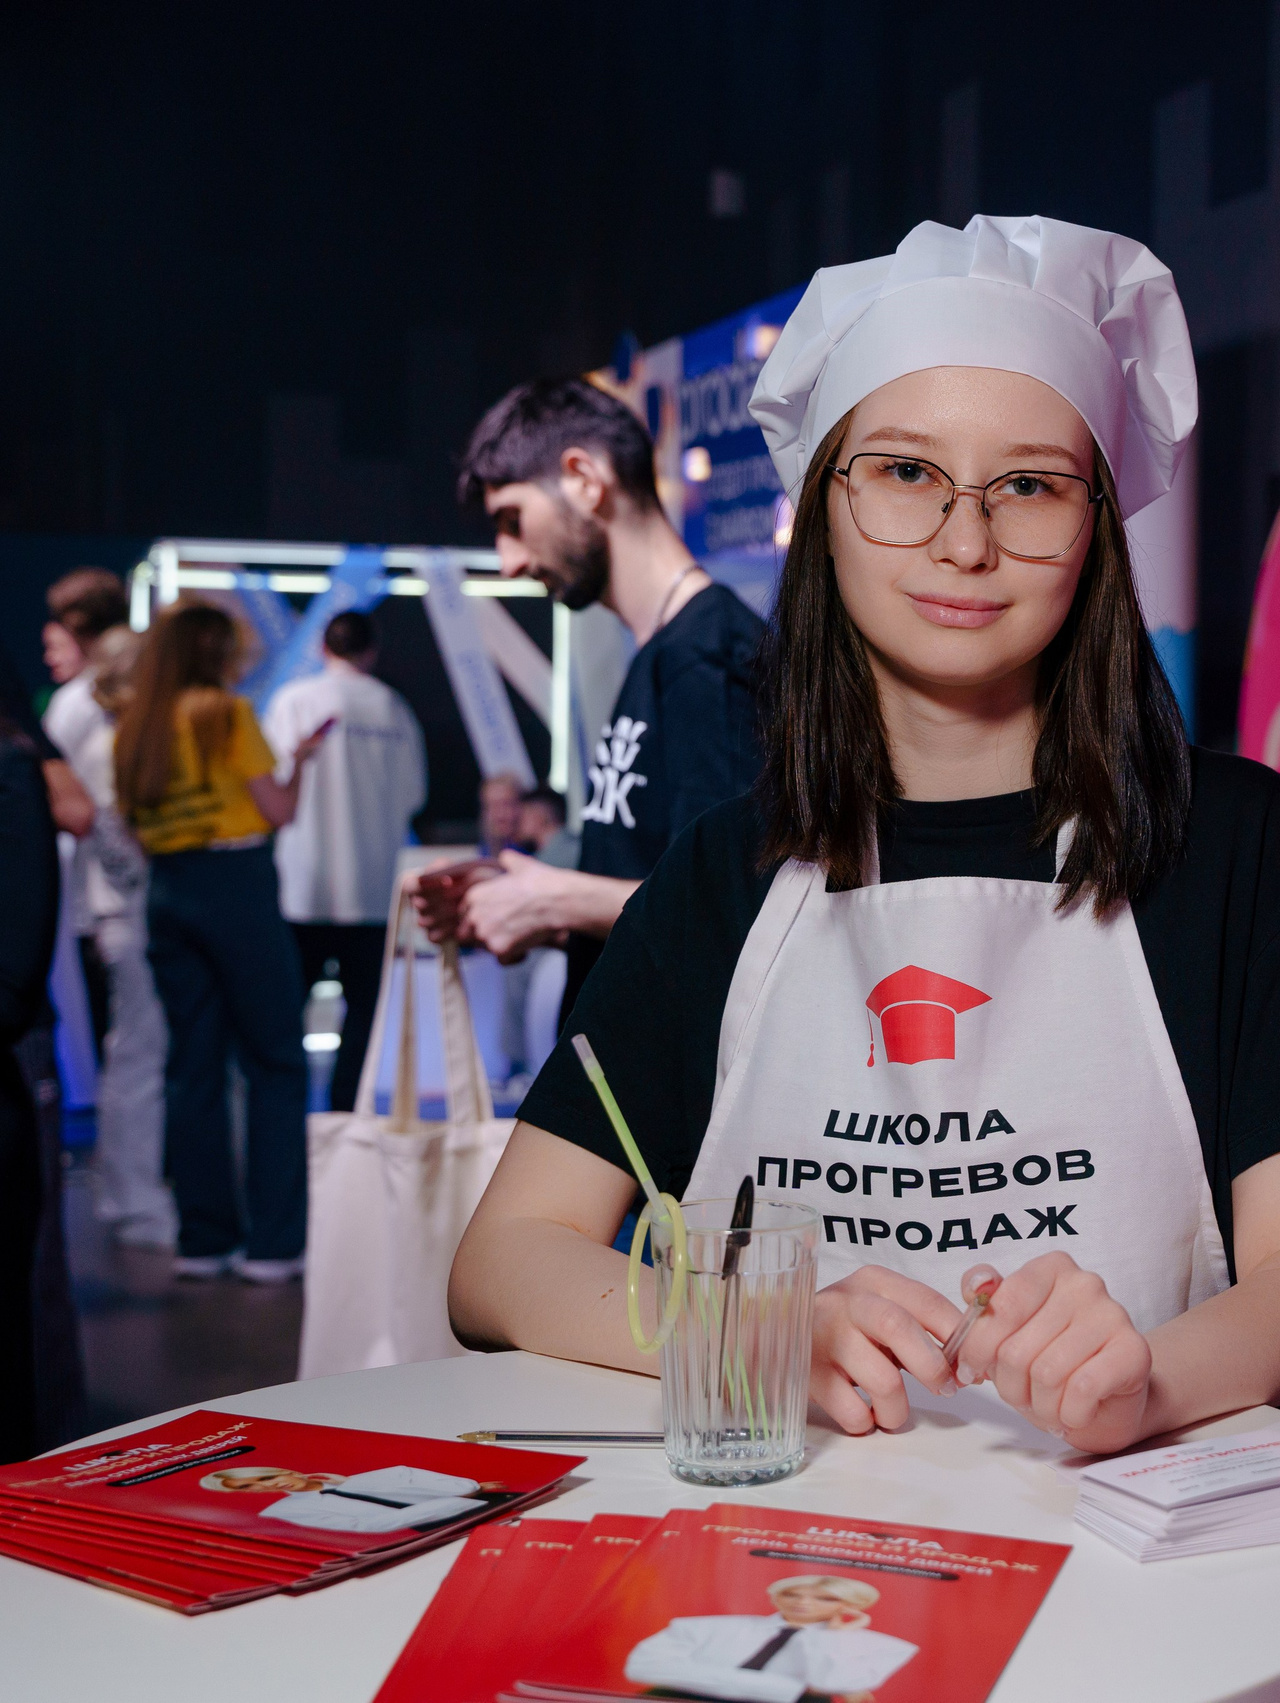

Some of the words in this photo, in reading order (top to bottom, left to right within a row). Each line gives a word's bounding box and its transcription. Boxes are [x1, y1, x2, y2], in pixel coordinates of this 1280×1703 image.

[823, 1108, 1017, 1146] ШКОЛА
[756, 1148, 1096, 1199] ПРОГРЕВОВ
[822, 1203, 1080, 1253] ПРОДАЖ
[63, 1442, 174, 1472] ШКОЛА
[156, 1421, 254, 1455] ПРОДАЖ
[191, 1434, 248, 1457] ДВЕРЕЙ
[702, 1524, 877, 1549] ПРОГРЕВОВ
[907, 1547, 1040, 1573] ПРОДАЖ
[731, 1536, 788, 1549] ДЕНЬ
[792, 1542, 906, 1562] ОТКРЫТЫХ
[908, 1556, 993, 1577] ДВЕРЕЙ
[806, 1526, 945, 1550] ШКОЛА
